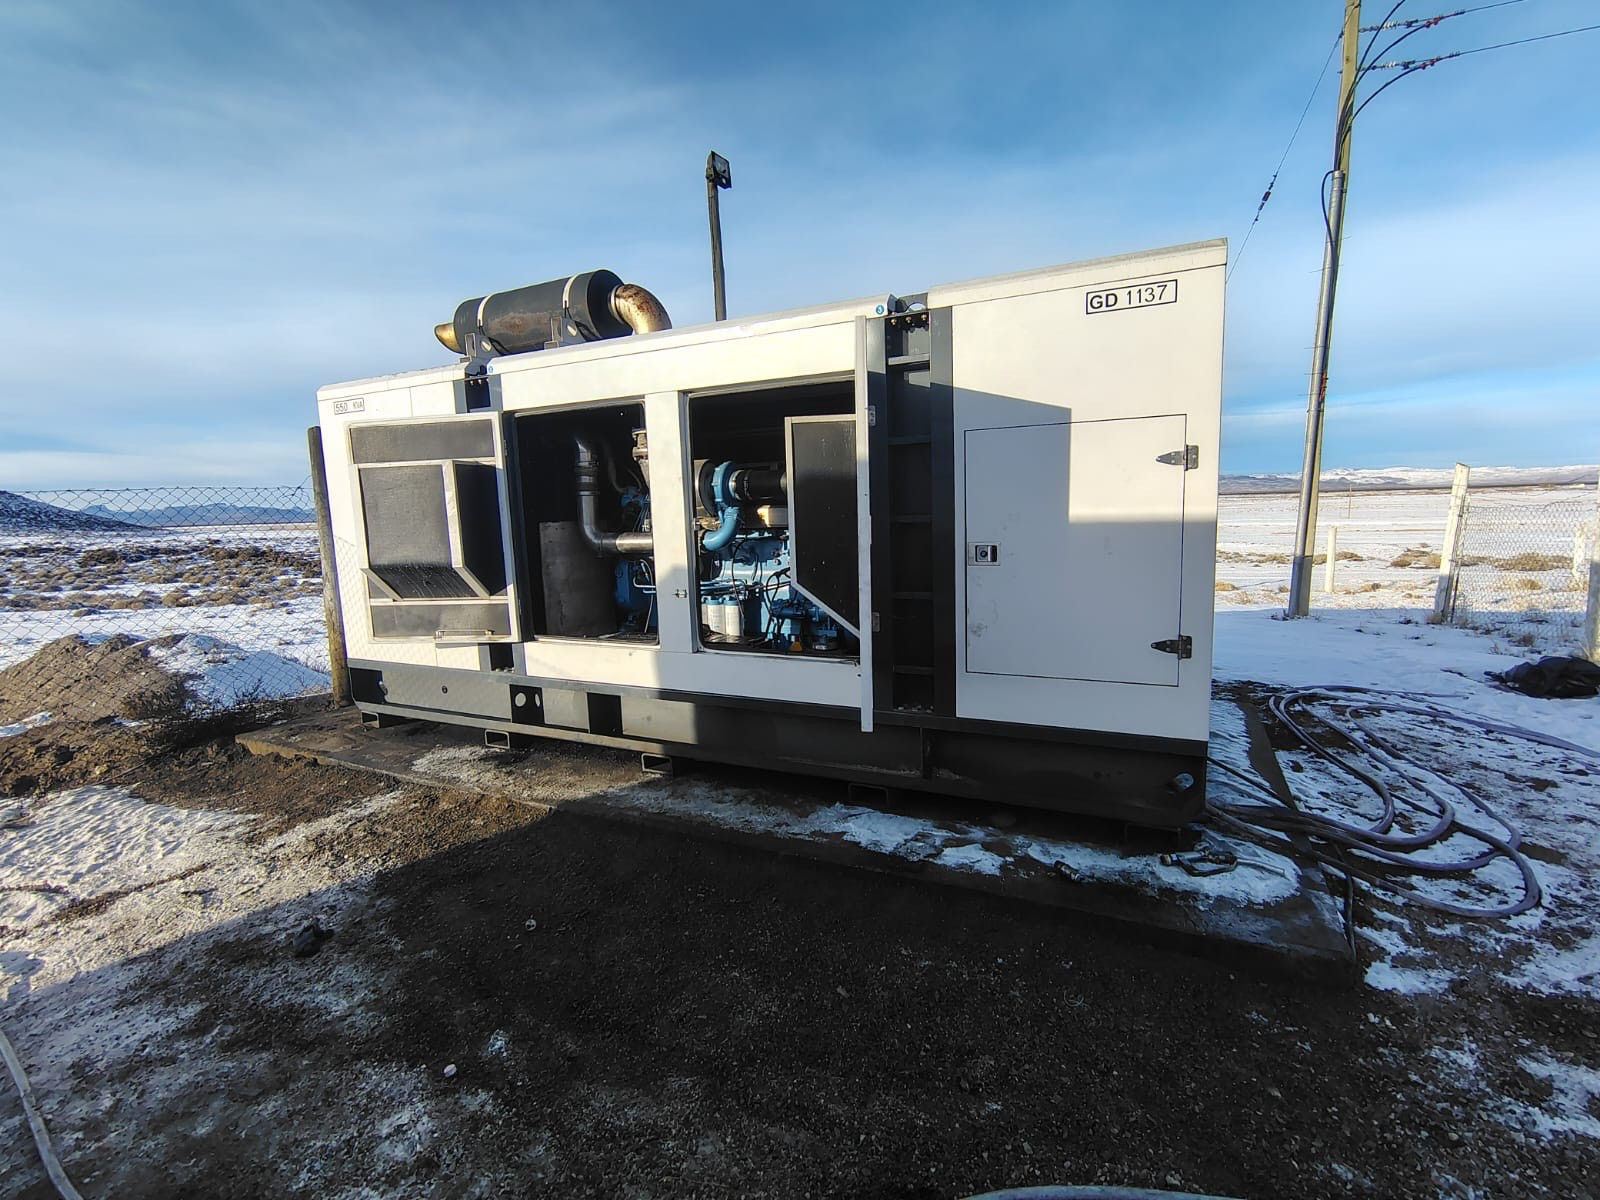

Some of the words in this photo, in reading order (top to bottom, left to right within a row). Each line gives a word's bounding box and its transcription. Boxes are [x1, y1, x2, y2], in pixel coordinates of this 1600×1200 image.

[1089, 293, 1118, 309] GD
[1126, 284, 1168, 305] 1137
[335, 402, 348, 413] 550
